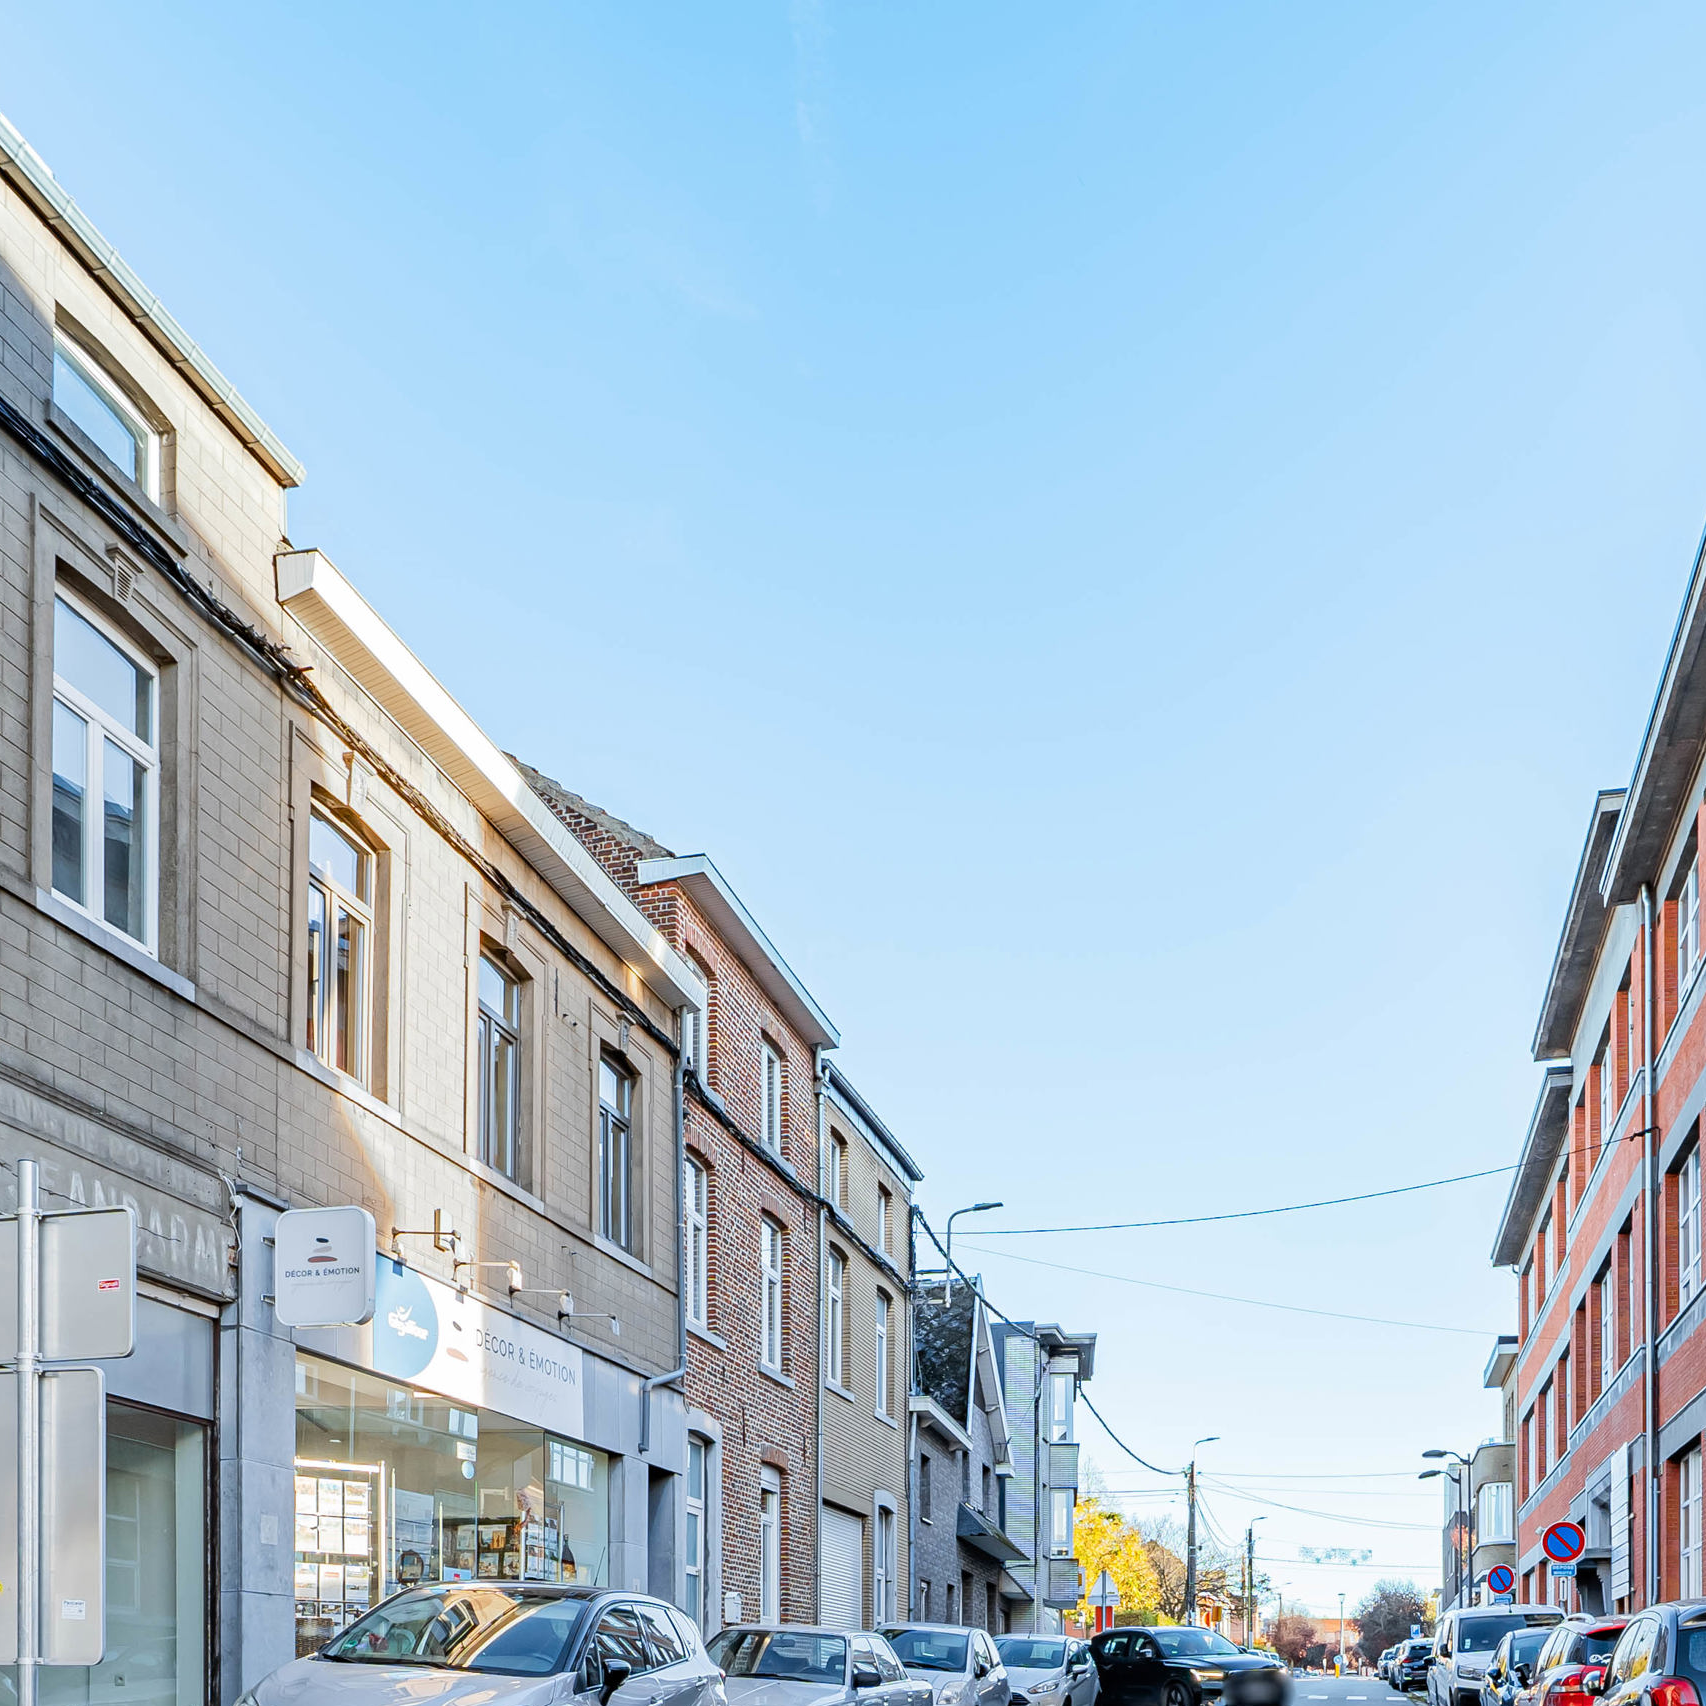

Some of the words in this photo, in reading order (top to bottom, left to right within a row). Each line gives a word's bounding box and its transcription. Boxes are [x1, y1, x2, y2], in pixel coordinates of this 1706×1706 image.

[323, 1266, 360, 1276] ÉMOTION
[519, 1347, 526, 1366] &
[529, 1348, 577, 1386] ÉMOTION
